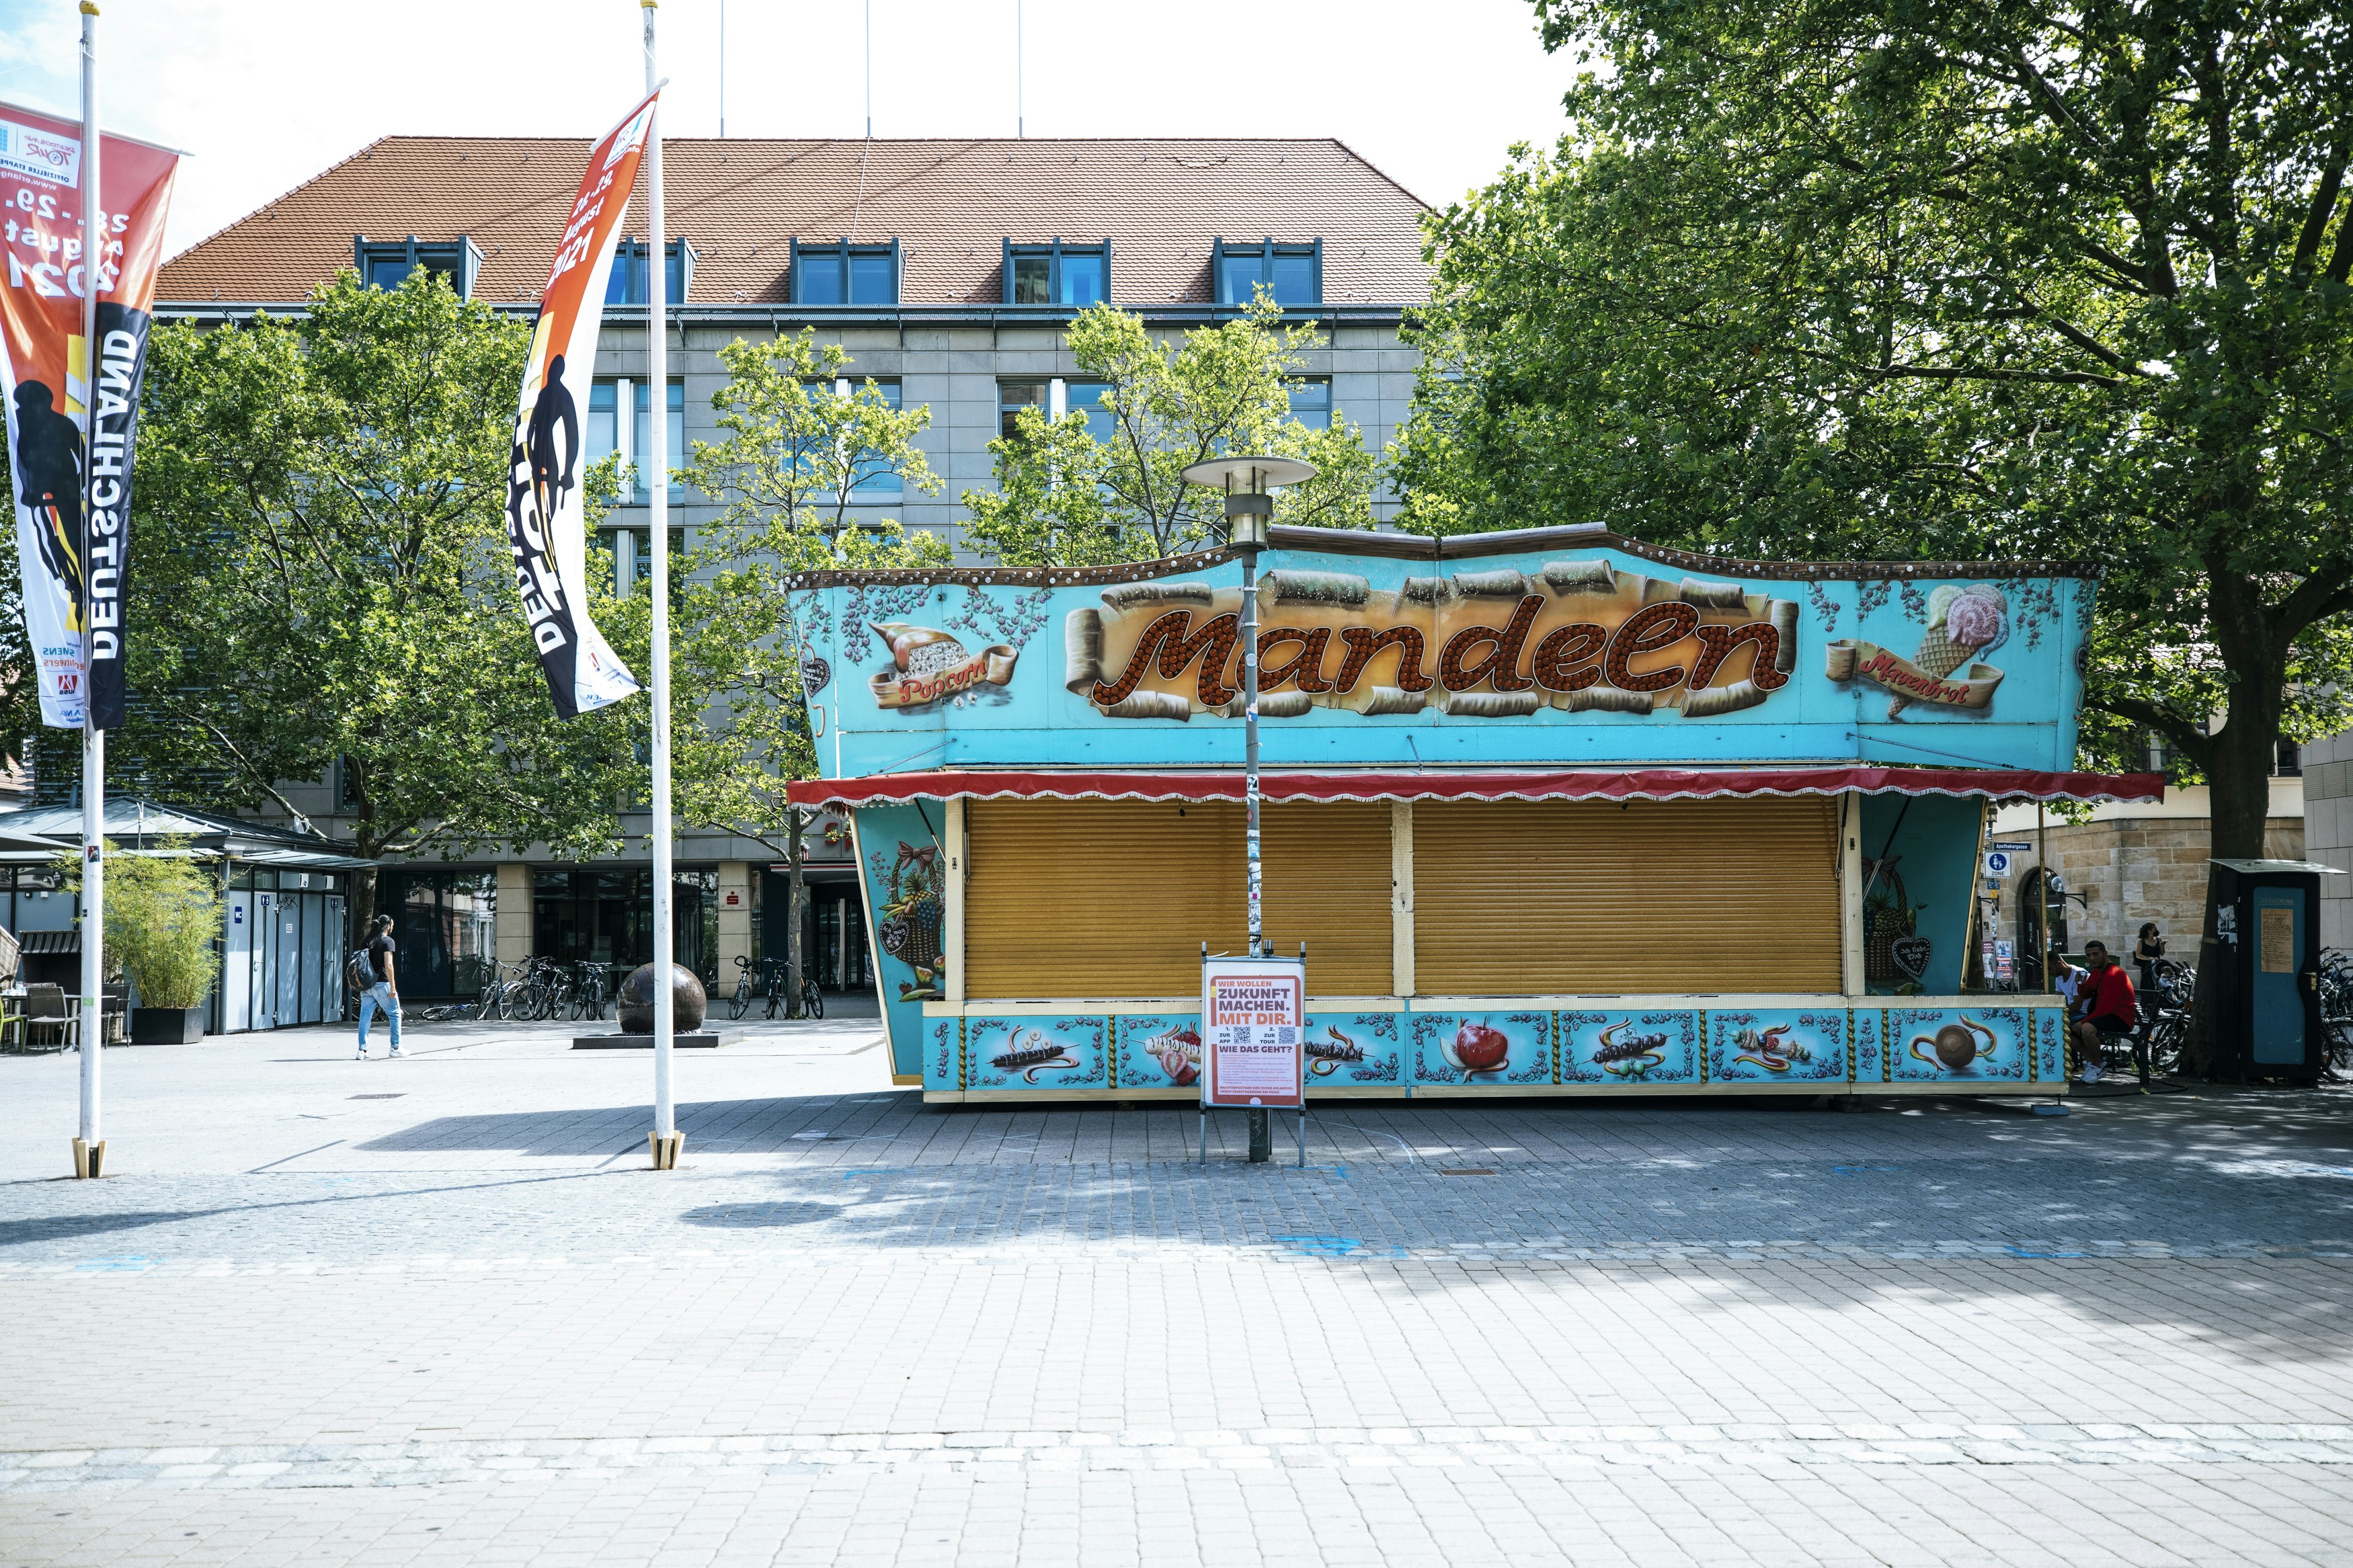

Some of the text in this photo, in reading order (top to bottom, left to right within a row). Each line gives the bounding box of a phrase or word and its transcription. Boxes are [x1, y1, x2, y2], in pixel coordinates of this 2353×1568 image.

[561, 195, 605, 247] August
[546, 226, 594, 290] 2021
[898, 661, 987, 702] Popcorn
[1860, 654, 1970, 704] Magenbrot
[883, 925, 891, 934] Ich
[1218, 988, 1290, 999] ZUKUNFT
[1219, 1000, 1290, 1011] MACHEN.
[1219, 1013, 1291, 1025] MIT DIR.
